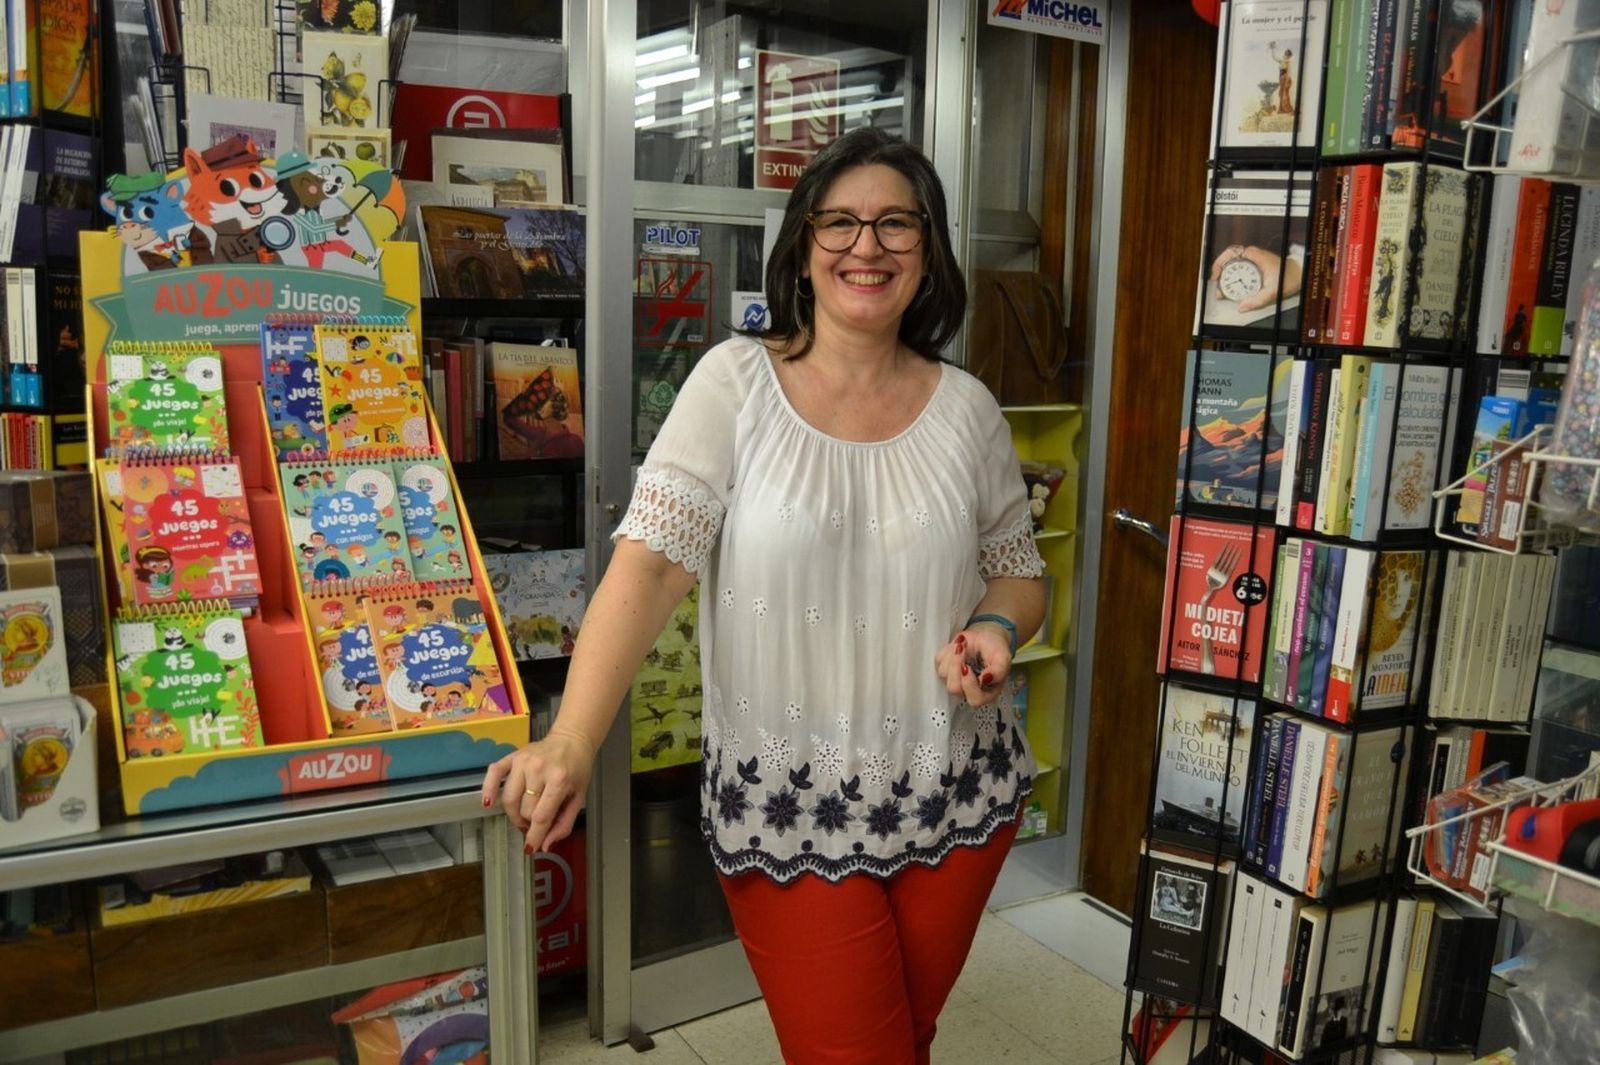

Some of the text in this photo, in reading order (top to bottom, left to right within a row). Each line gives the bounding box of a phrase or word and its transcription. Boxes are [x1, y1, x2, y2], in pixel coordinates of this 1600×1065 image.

[763, 162, 807, 178] EXTIN
[1215, 191, 1239, 200] olstói
[1555, 195, 1575, 258] LUCINDA
[647, 226, 700, 247] PILOT
[1550, 259, 1567, 300] RILEY
[154, 272, 273, 318] AUZOU
[359, 368, 382, 384] 45
[1199, 378, 1232, 387] HOMAS
[149, 383, 176, 397] 45
[1198, 387, 1222, 396] ANN
[1402, 388, 1437, 403] ombre
[329, 496, 354, 513] 45
[400, 491, 411, 506] 5
[171, 499, 199, 516] 45
[1185, 603, 1202, 620] MI
[356, 628, 371, 645] 4
[418, 629, 444, 648] 45
[1191, 622, 1237, 644] COJEA
[1177, 640, 1200, 651] AITOR
[165, 653, 195, 671] 45
[1372, 661, 1409, 671] MONFORT
[421, 672, 431, 681] de
[1362, 675, 1376, 696] A
[1172, 719, 1204, 738] KEN
[1166, 750, 1175, 760] EL
[1262, 717, 1282, 803] DANIELLE STEEL
[298, 752, 373, 780] AUZOU
[1176, 763, 1190, 774] DEL
[1276, 725, 1297, 809] DANIELLE STEEL
